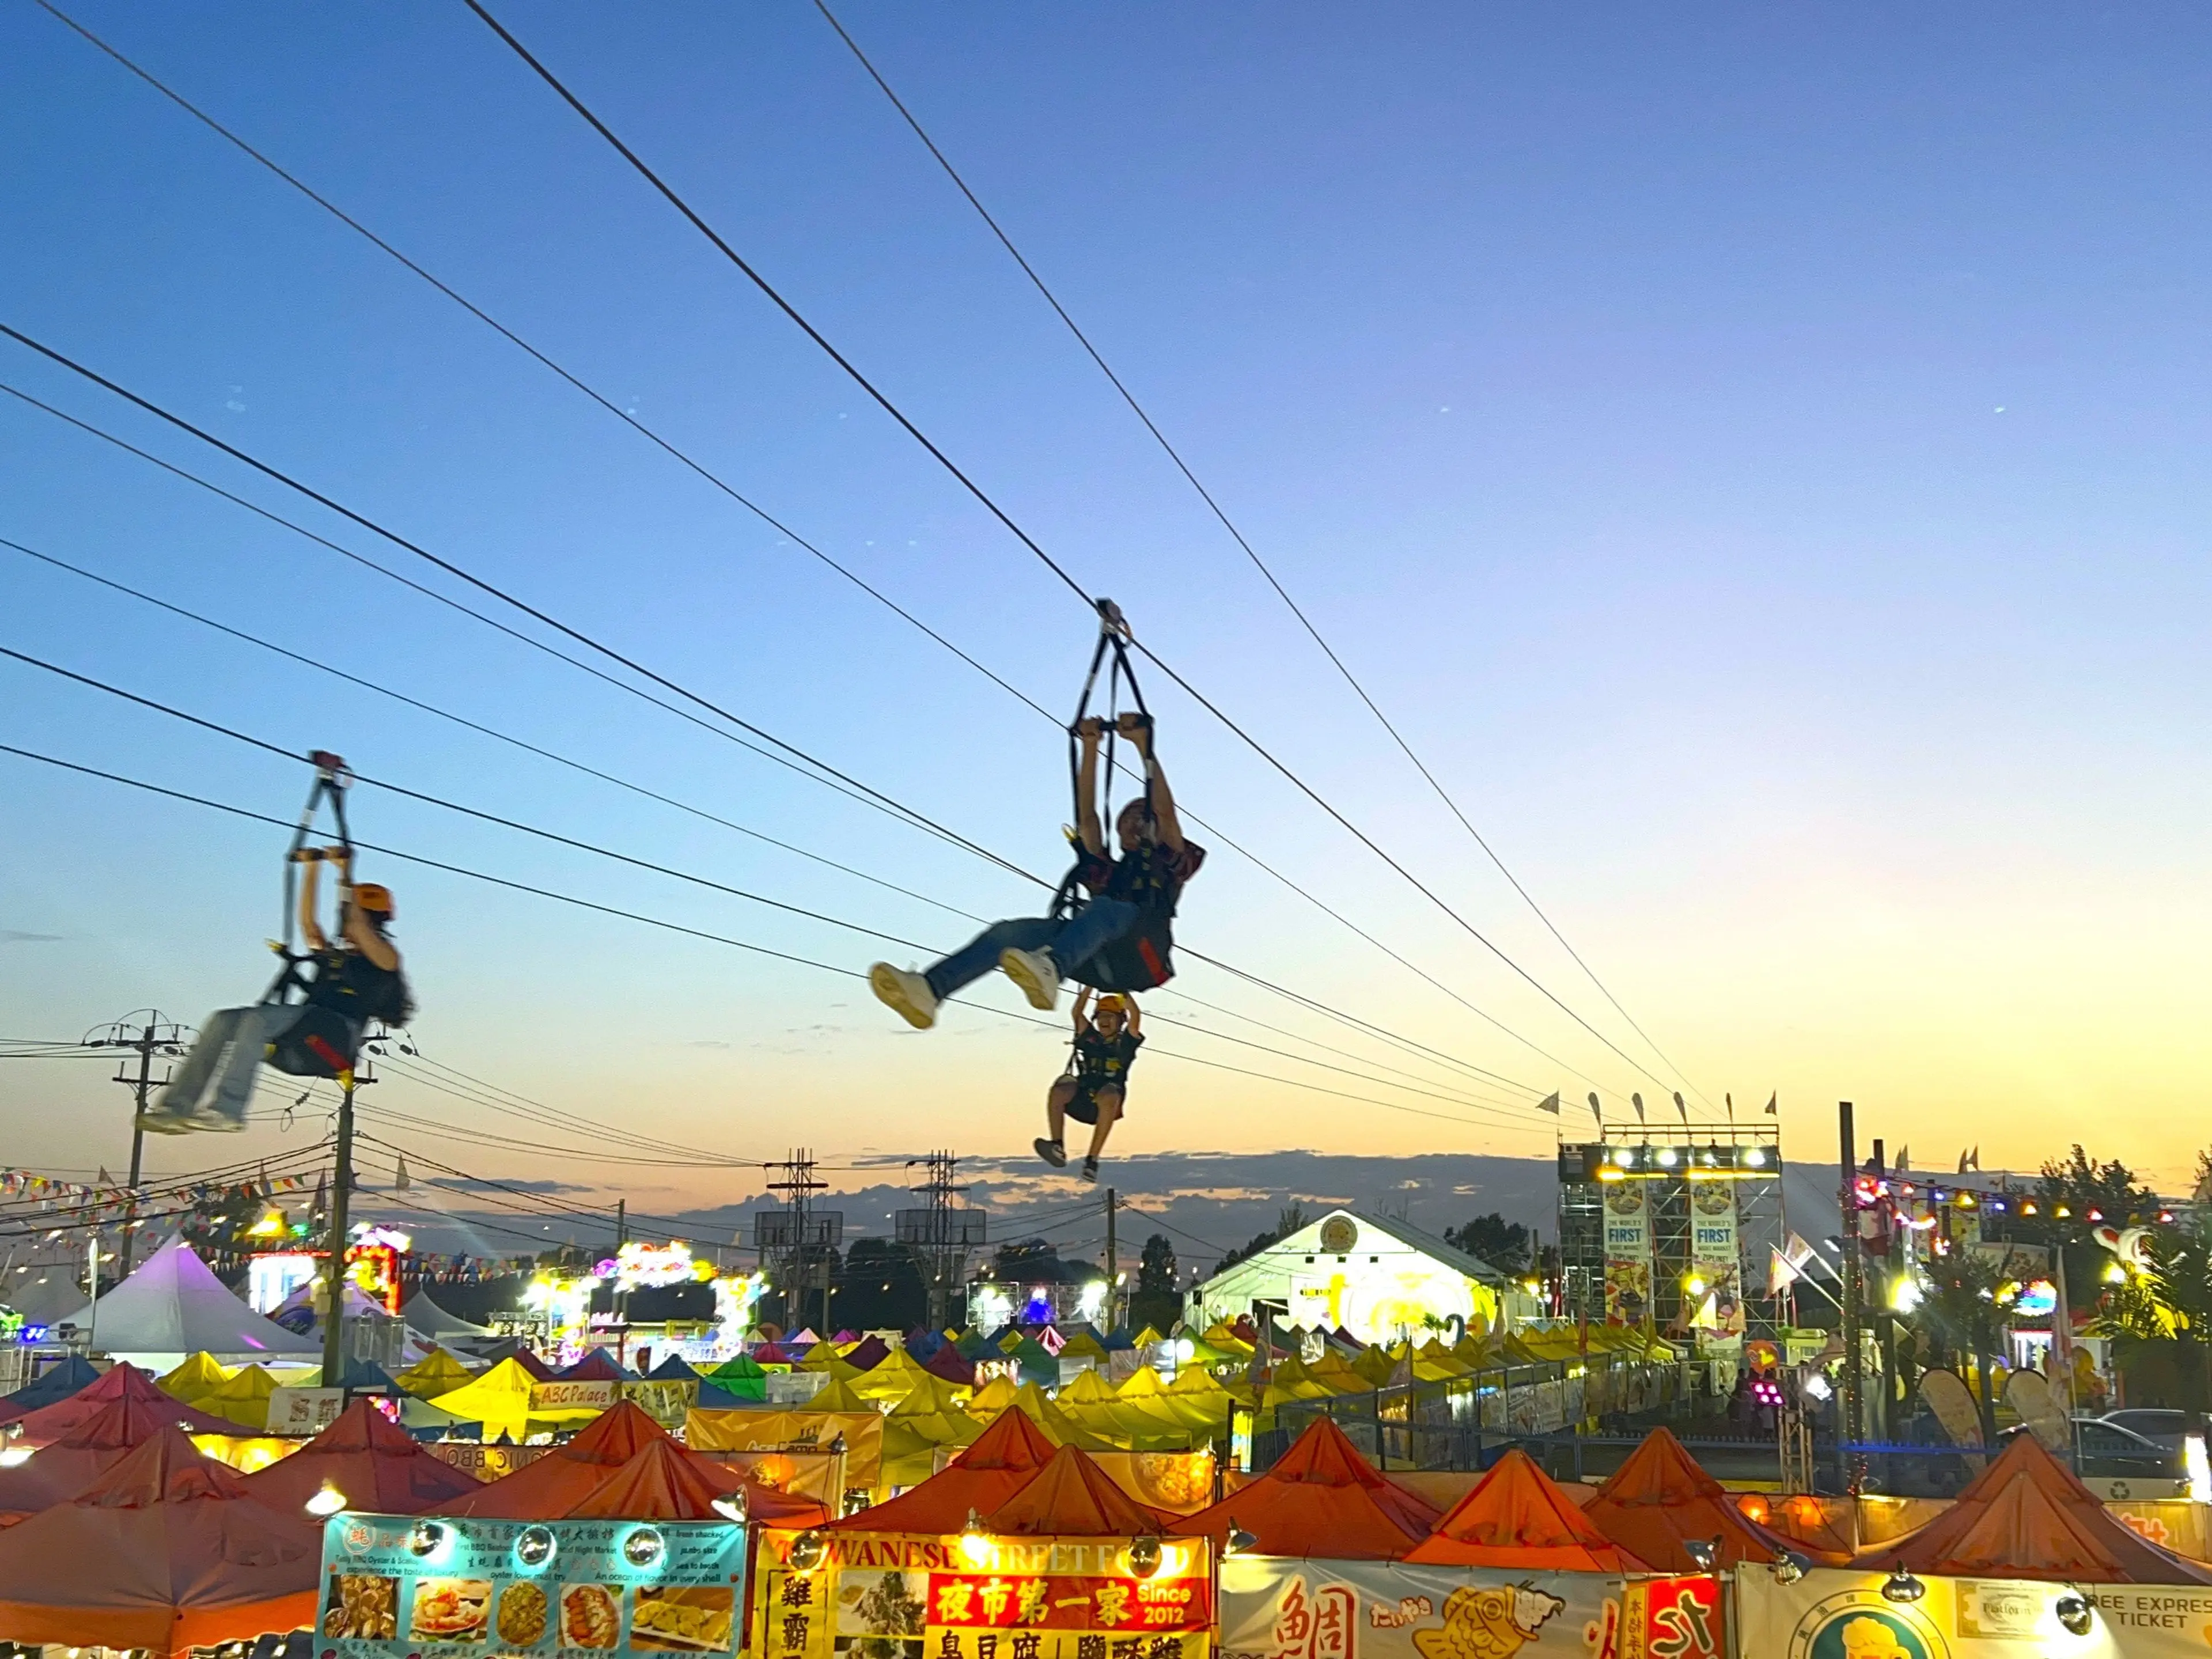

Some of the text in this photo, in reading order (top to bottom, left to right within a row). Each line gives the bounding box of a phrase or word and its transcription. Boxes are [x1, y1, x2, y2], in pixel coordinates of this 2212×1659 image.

[1609, 1229, 1642, 1243] FIRST
[1697, 1229, 1732, 1243] FIRST
[541, 1385, 569, 1404] ABC
[571, 1385, 607, 1403] Palace
[778, 1540, 1190, 1574] TWANESE STREET FOD
[347, 1566, 386, 1575] experience
[594, 1572, 607, 1580] An
[702, 1574, 721, 1582] shell
[937, 1578, 1133, 1626] 夜市第一家
[1137, 1585, 1191, 1603] Since
[2088, 1594, 2124, 1609] REE
[781, 1575, 813, 1659] 雞霸
[1143, 1607, 1184, 1624] 2012
[1270, 1580, 1355, 1659] 鯛
[1370, 1595, 1434, 1628] たいやき
[2116, 1612, 2187, 1628] TICKET
